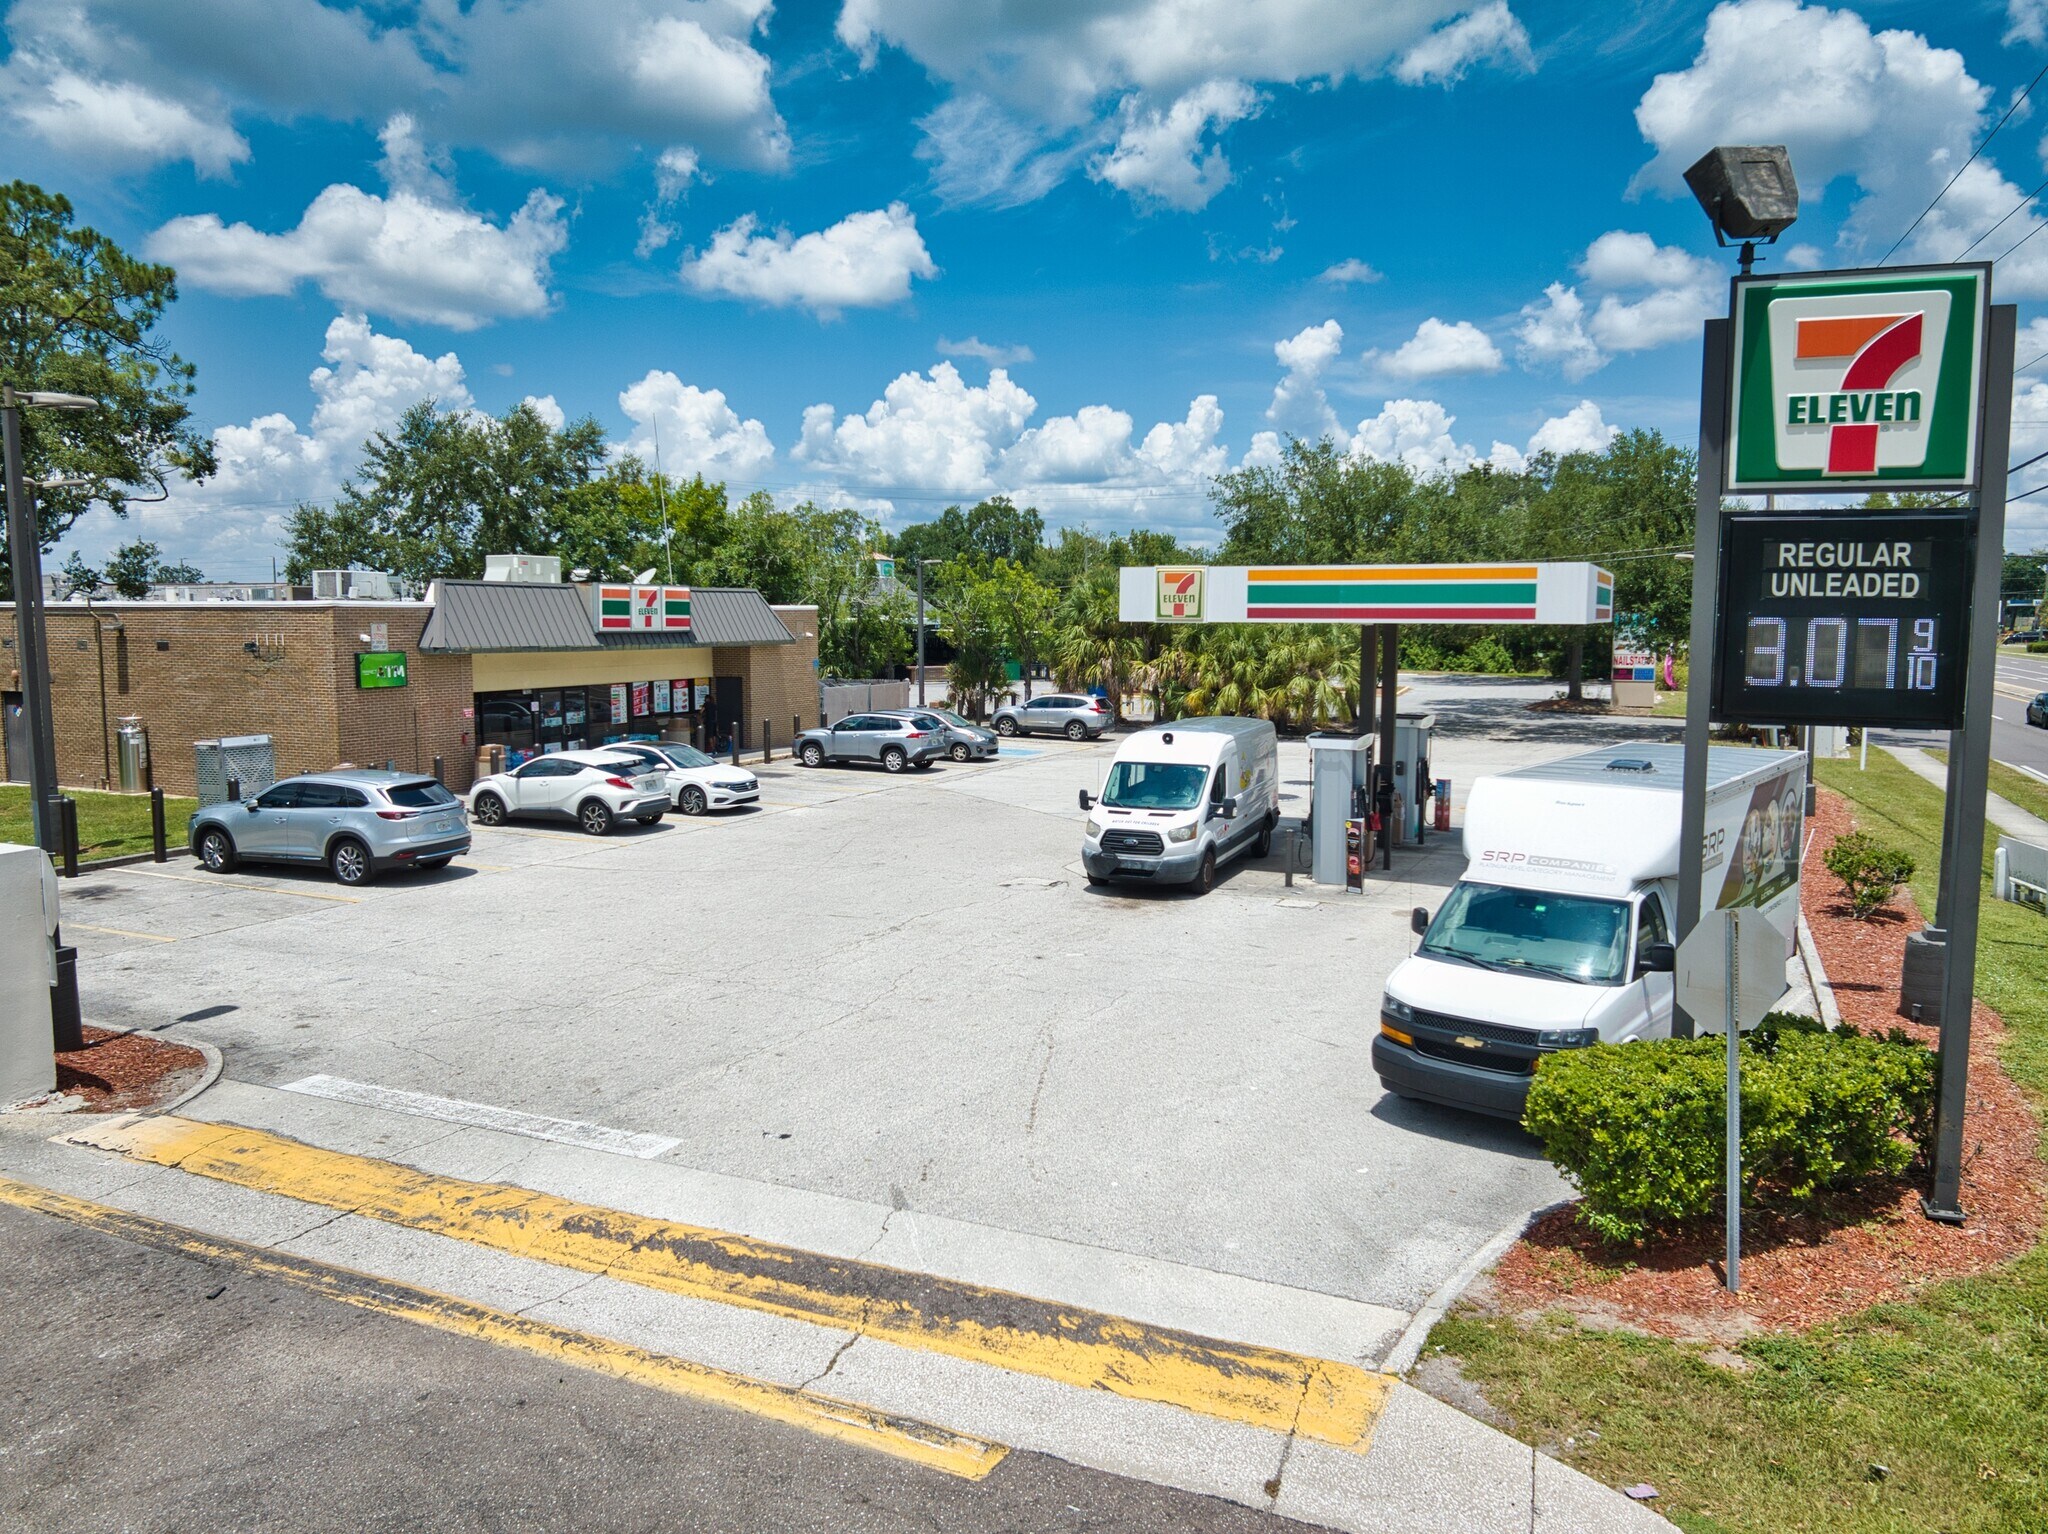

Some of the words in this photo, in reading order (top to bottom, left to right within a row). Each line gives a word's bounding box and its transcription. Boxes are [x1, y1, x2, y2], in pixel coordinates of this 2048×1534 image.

[1796, 311, 1924, 474] 7
[1779, 542, 1911, 567] REGULAR
[1164, 572, 1195, 616] 7
[1771, 573, 1920, 598] UNLEADED
[639, 590, 658, 628] 7
[1614, 656, 1634, 666] NAILS
[1745, 617, 1898, 689] 3.07
[376, 665, 405, 678] ATM
[1481, 850, 1526, 863] SRP
[1529, 856, 1616, 874] COMPANIES
[1527, 867, 1563, 876] CATEGORY
[1564, 871, 1616, 881] MANAGEMENT
